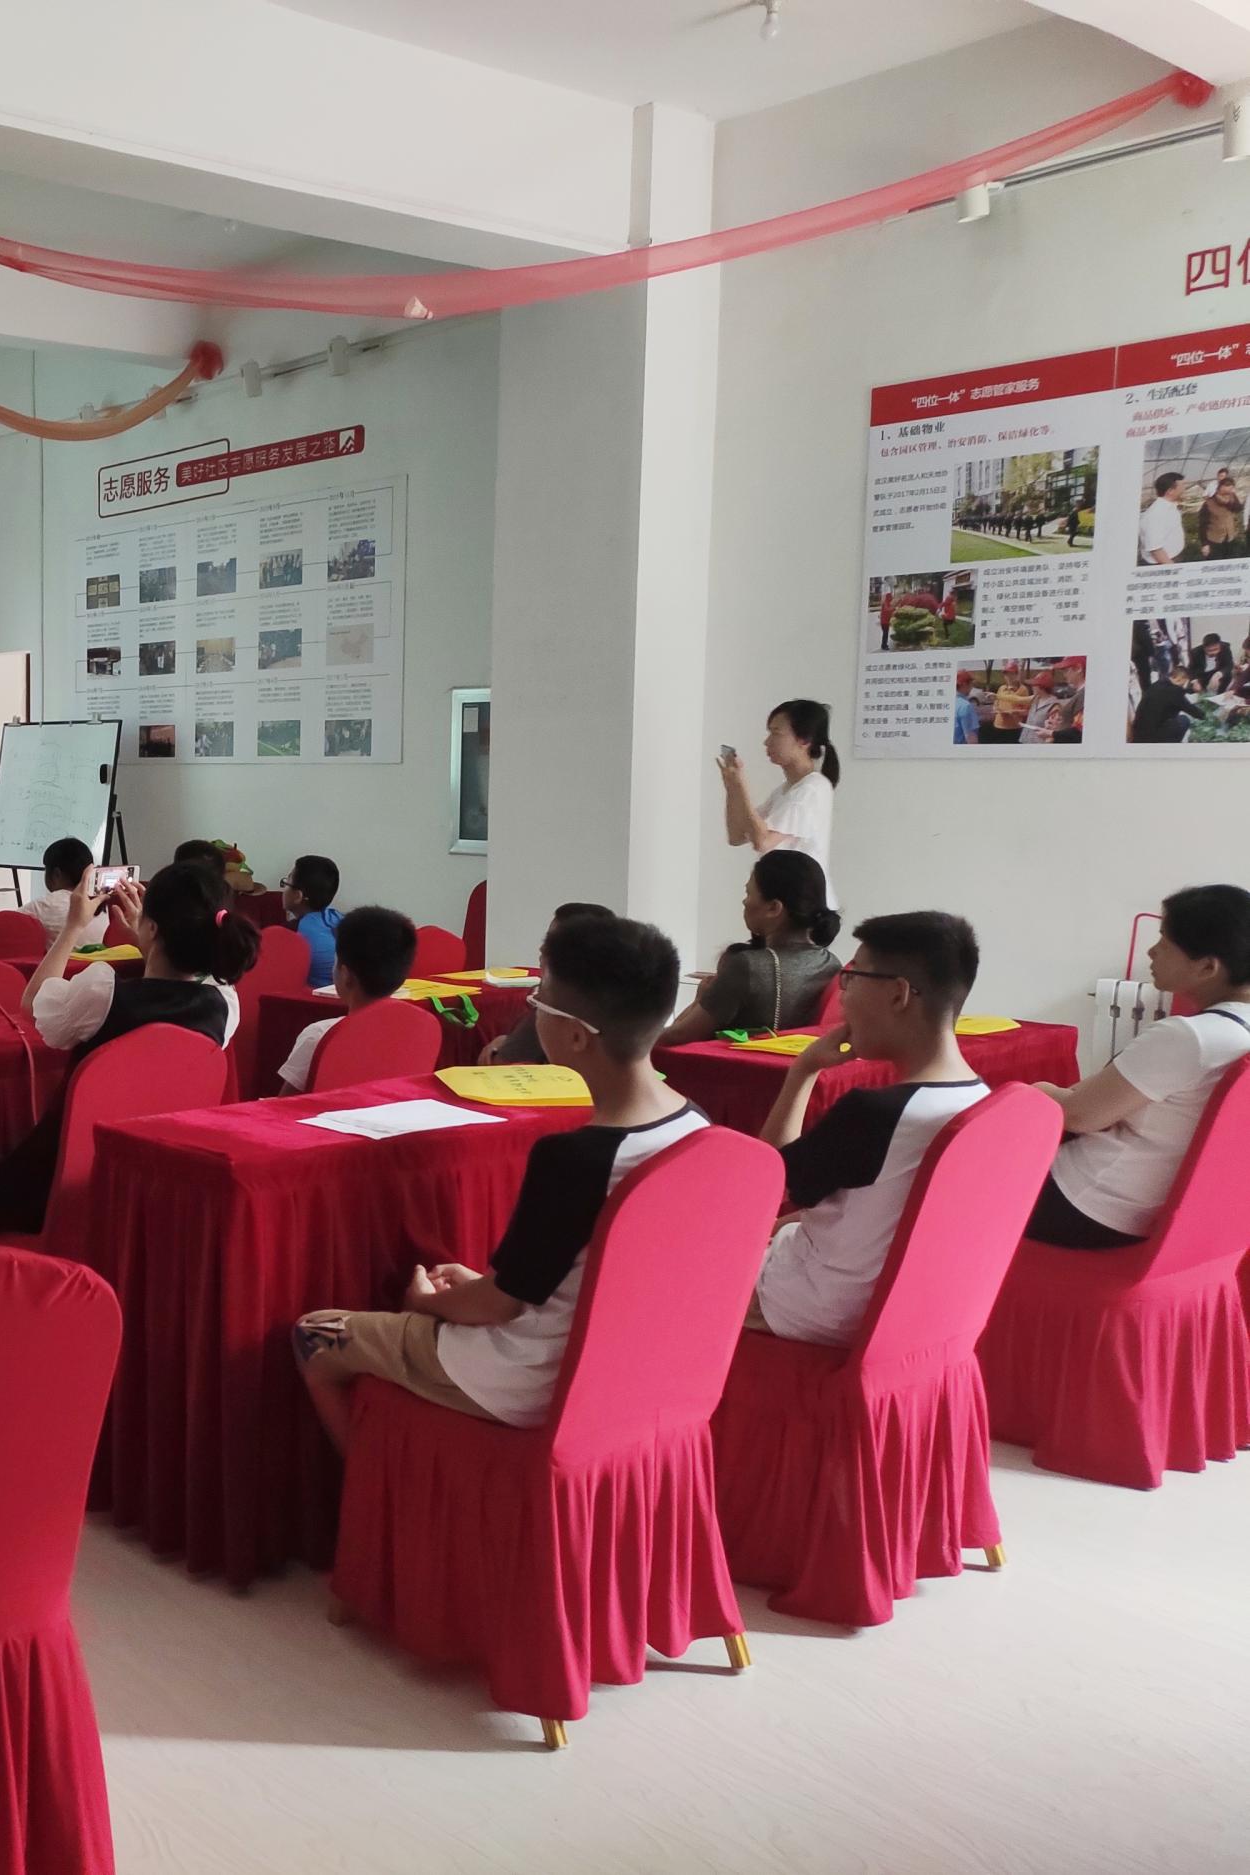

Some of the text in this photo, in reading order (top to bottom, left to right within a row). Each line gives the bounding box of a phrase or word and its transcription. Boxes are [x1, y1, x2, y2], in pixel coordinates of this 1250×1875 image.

[1185, 236, 1250, 296] 四
[180, 436, 336, 483] 美好社区志愿服务发展之路
[102, 466, 171, 503] 志愿服务
